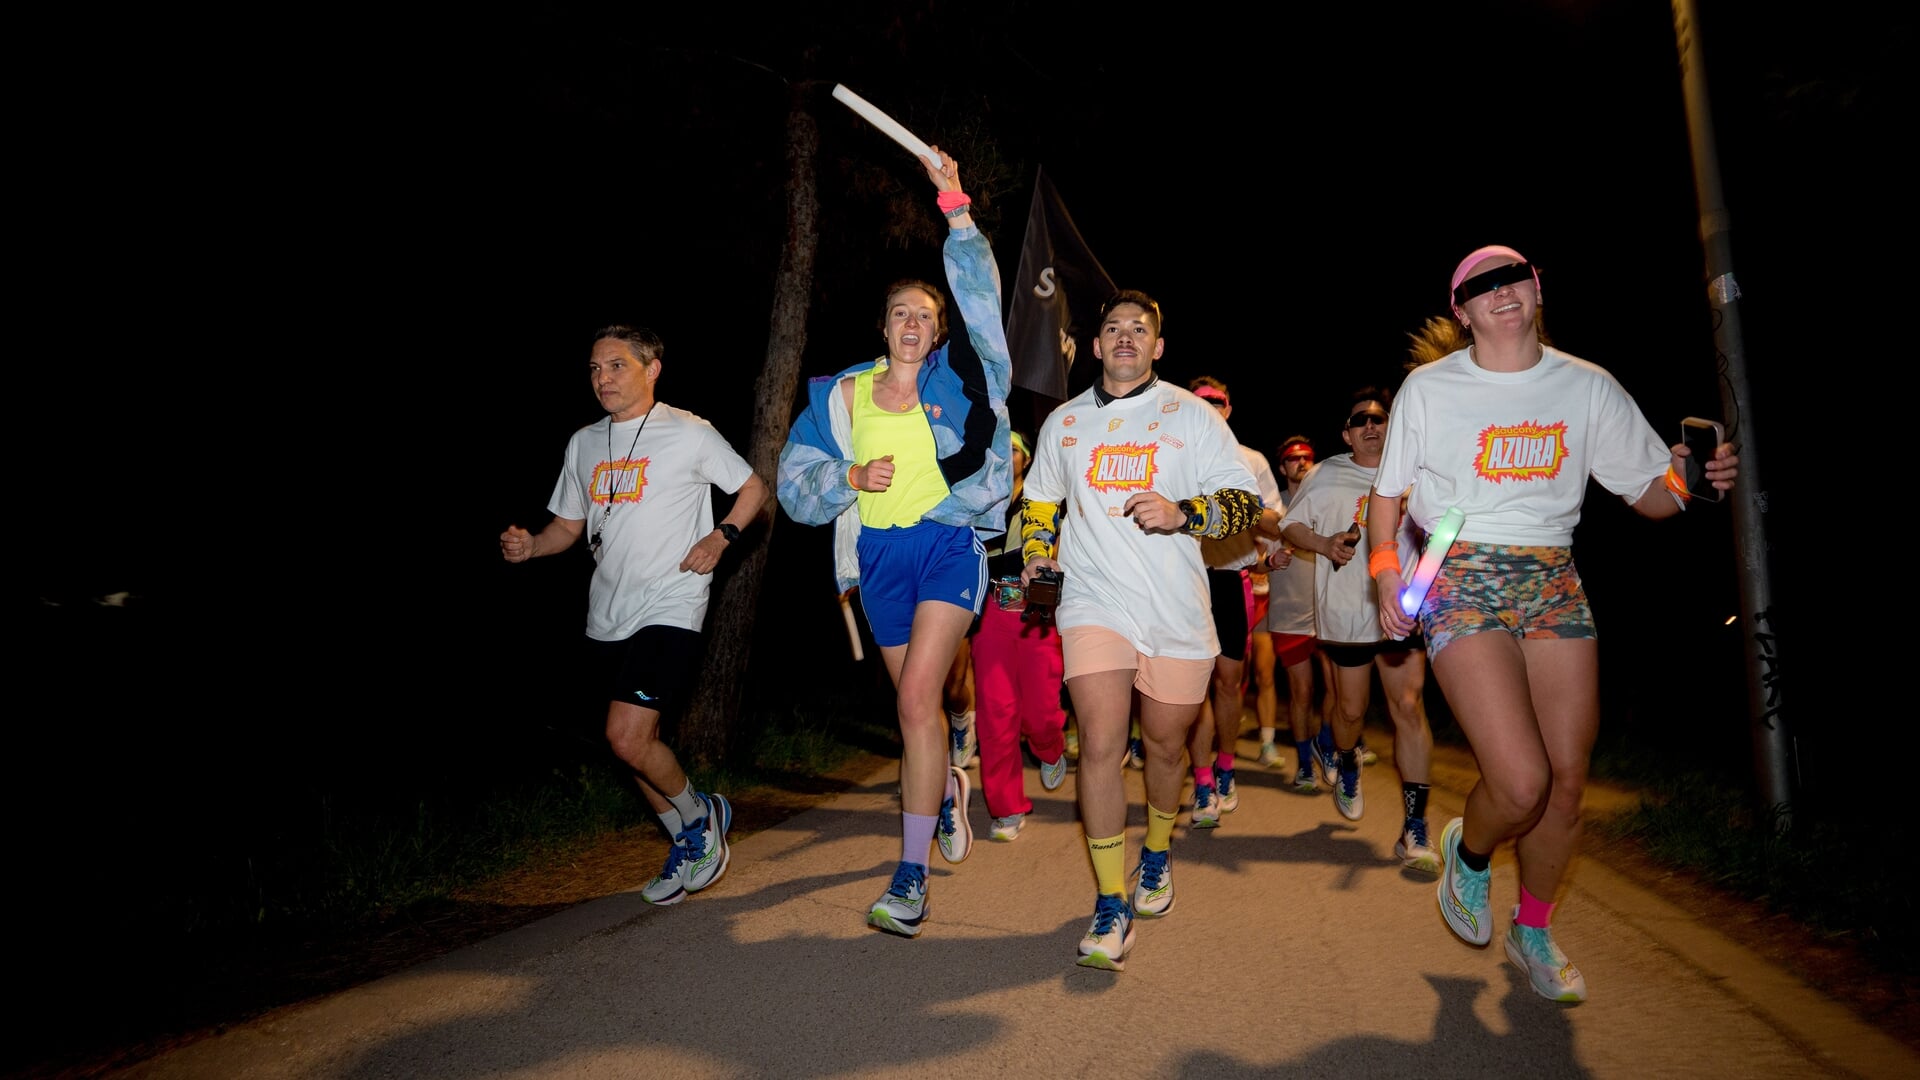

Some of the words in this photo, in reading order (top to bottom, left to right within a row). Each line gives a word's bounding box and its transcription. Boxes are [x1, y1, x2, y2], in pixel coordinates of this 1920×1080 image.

[1494, 426, 1537, 435] saucony
[1487, 434, 1556, 469] AZURA
[1096, 453, 1148, 481] AZURA
